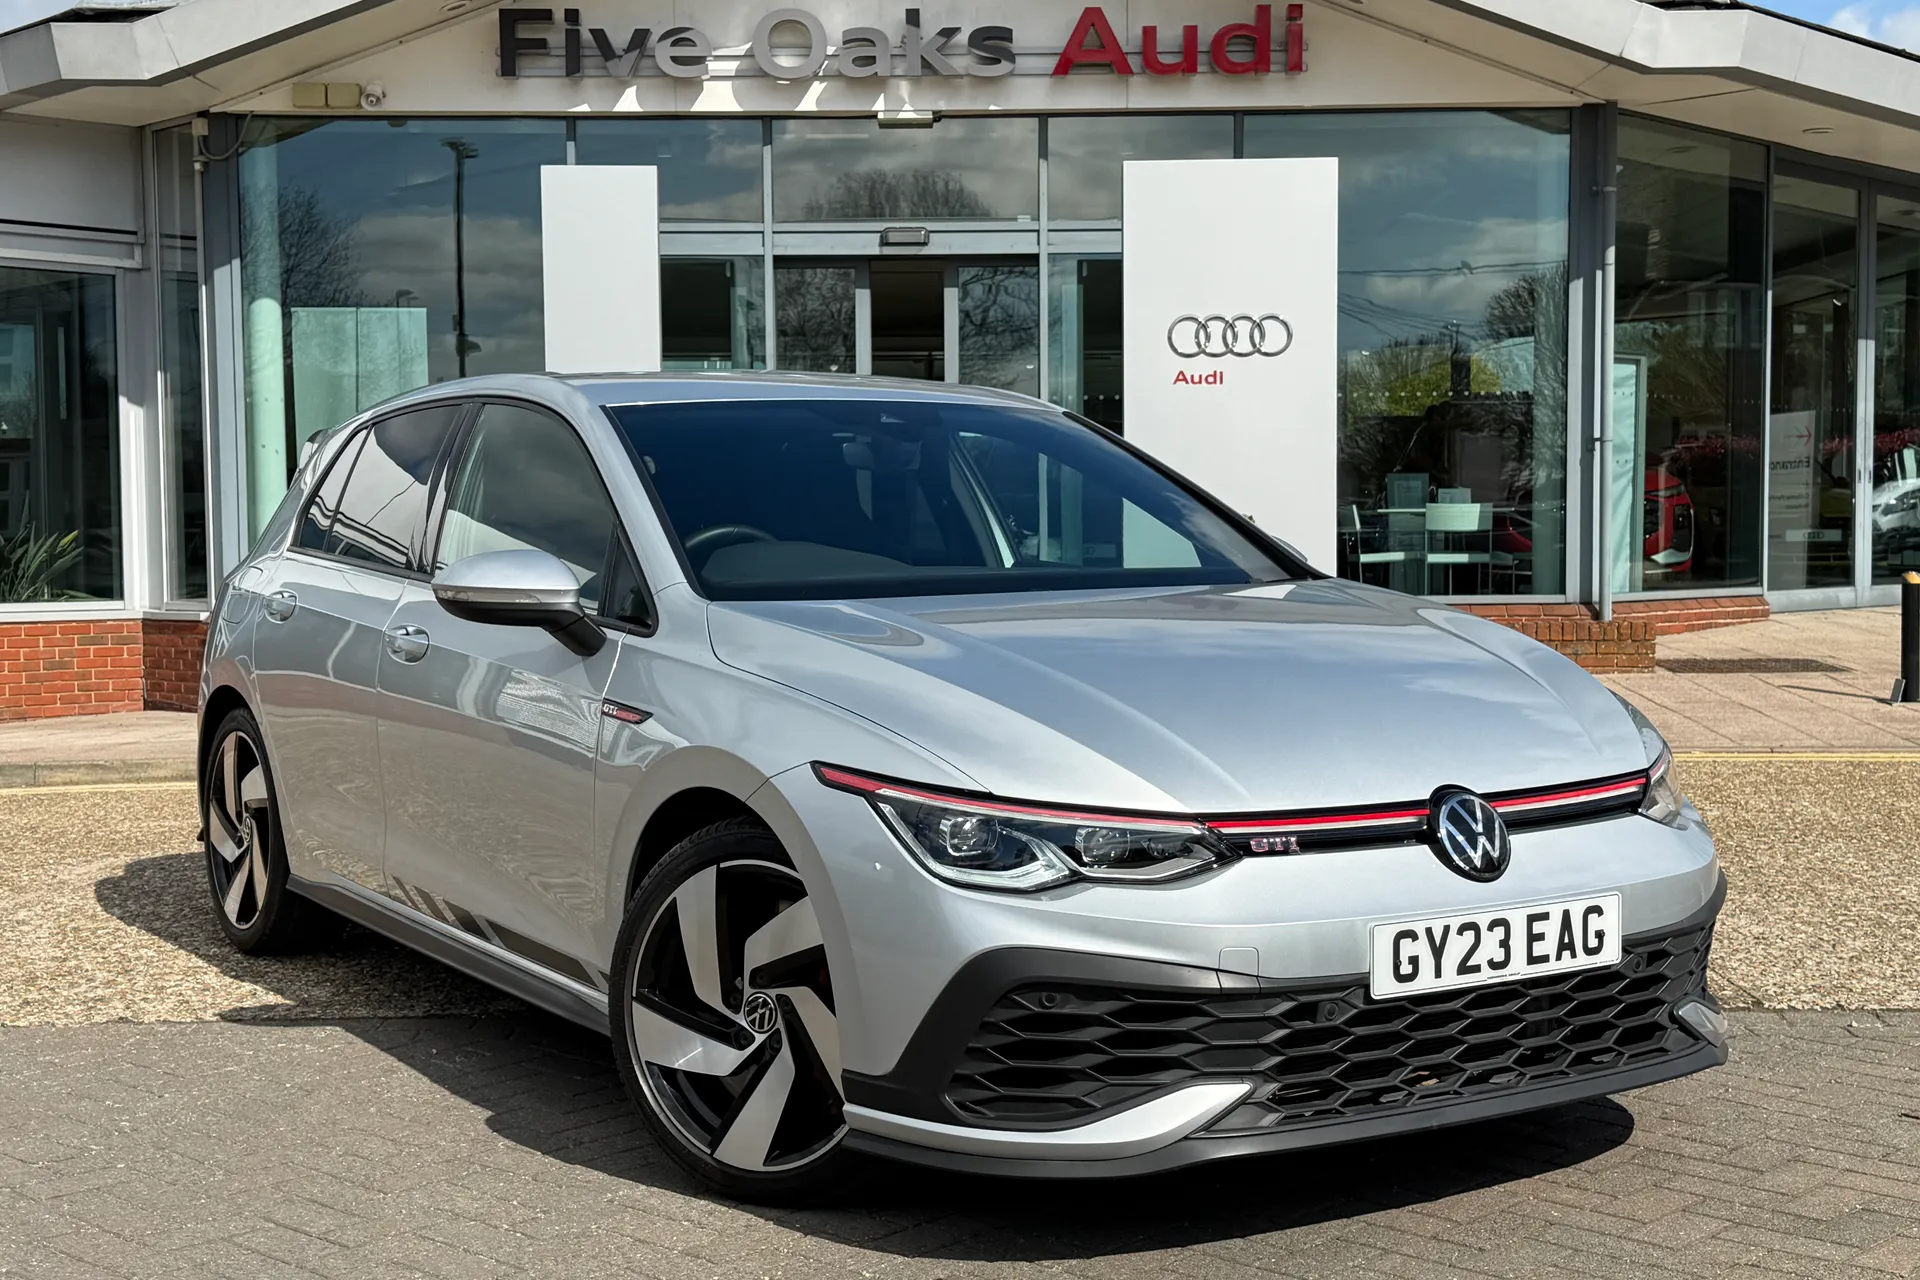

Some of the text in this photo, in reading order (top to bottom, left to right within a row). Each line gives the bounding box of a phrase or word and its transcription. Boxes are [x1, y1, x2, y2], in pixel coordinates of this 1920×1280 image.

[499, 4, 1303, 79] Five Oaks Audi
[1172, 370, 1224, 385] Audi
[603, 703, 618, 715] GTI
[1250, 836, 1300, 854] GTI
[1392, 904, 1604, 983] GY23 EAG
